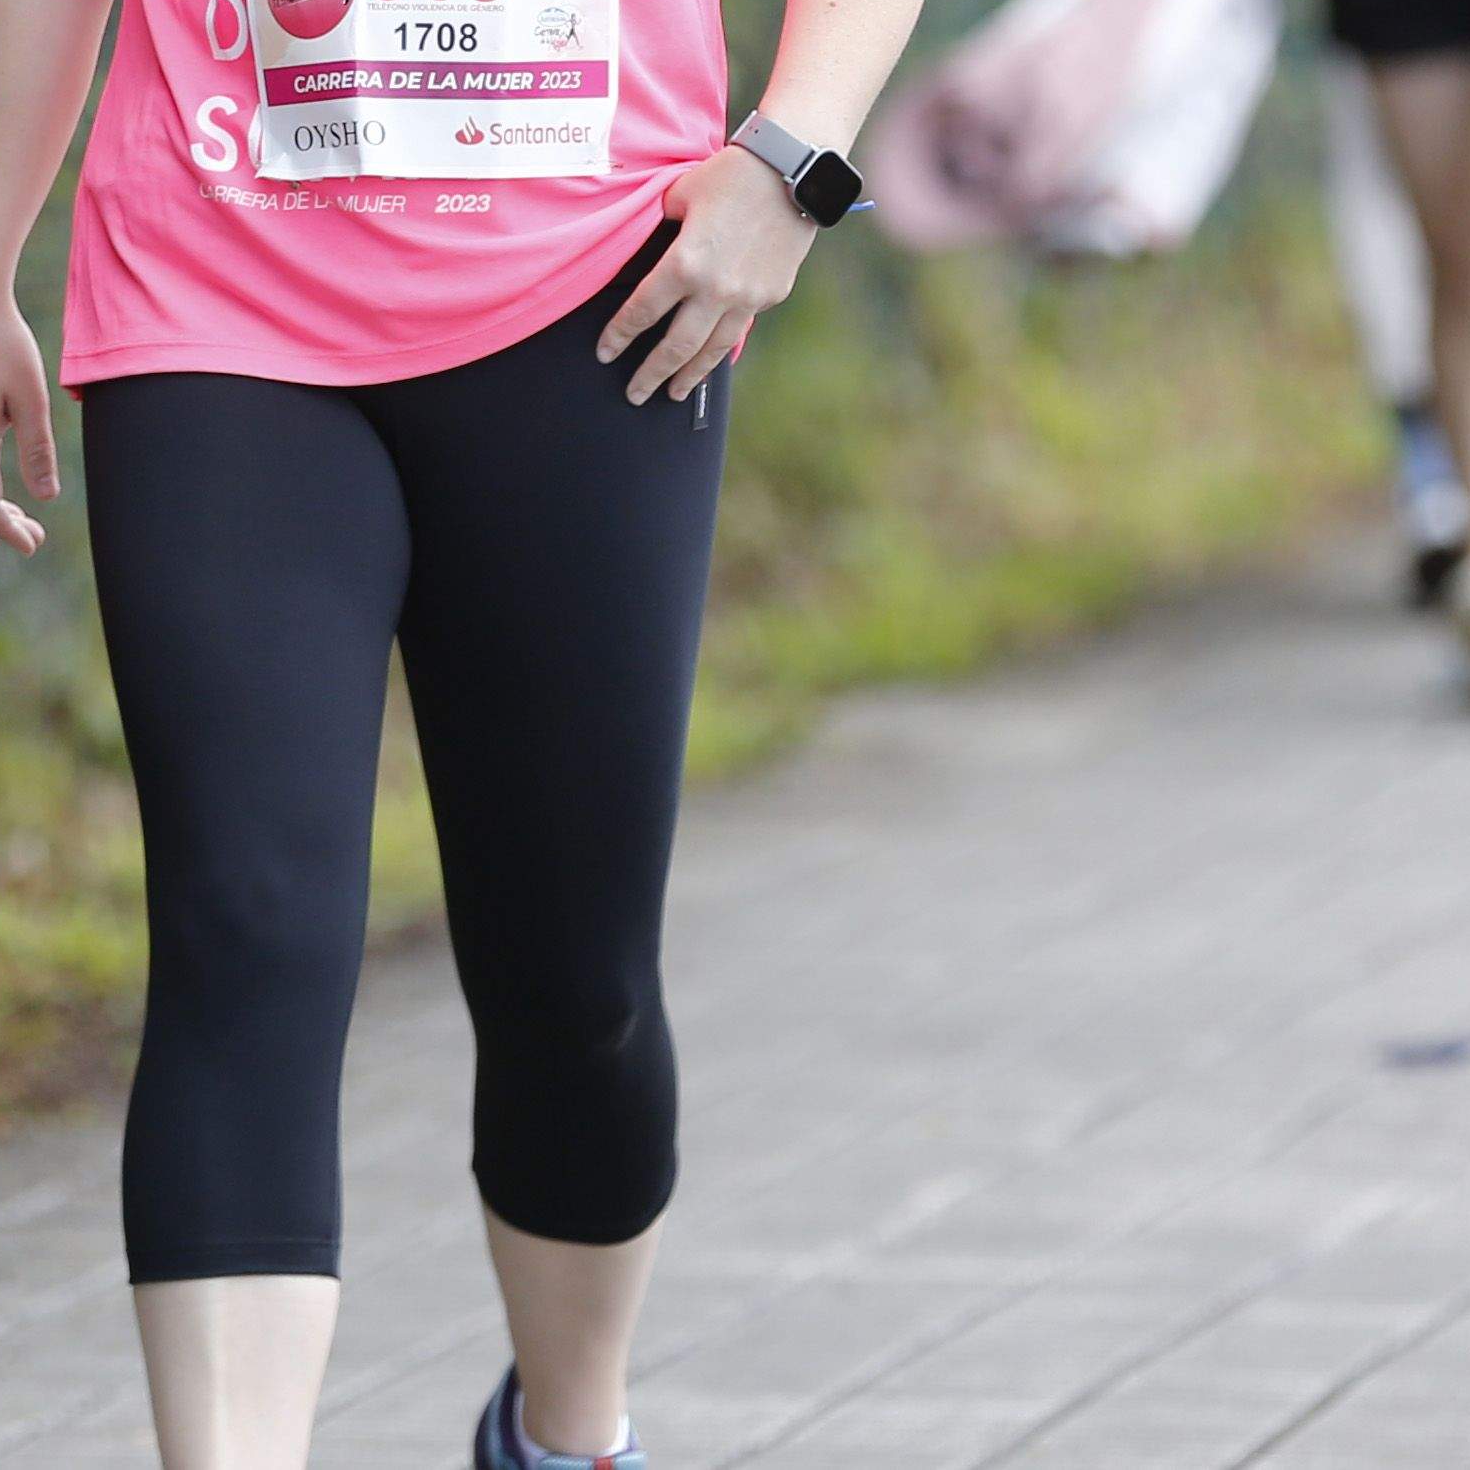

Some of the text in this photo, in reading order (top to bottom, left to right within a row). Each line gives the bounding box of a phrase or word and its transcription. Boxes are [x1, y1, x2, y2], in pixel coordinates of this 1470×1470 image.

[394, 22, 478, 52] 1708
[294, 70, 582, 93] CARRERA DE LA MUJER 2023
[294, 120, 386, 152] OYSHO
[490, 123, 592, 145] Santander
[283, 191, 310, 211] DE
[435, 194, 493, 213] 2023
